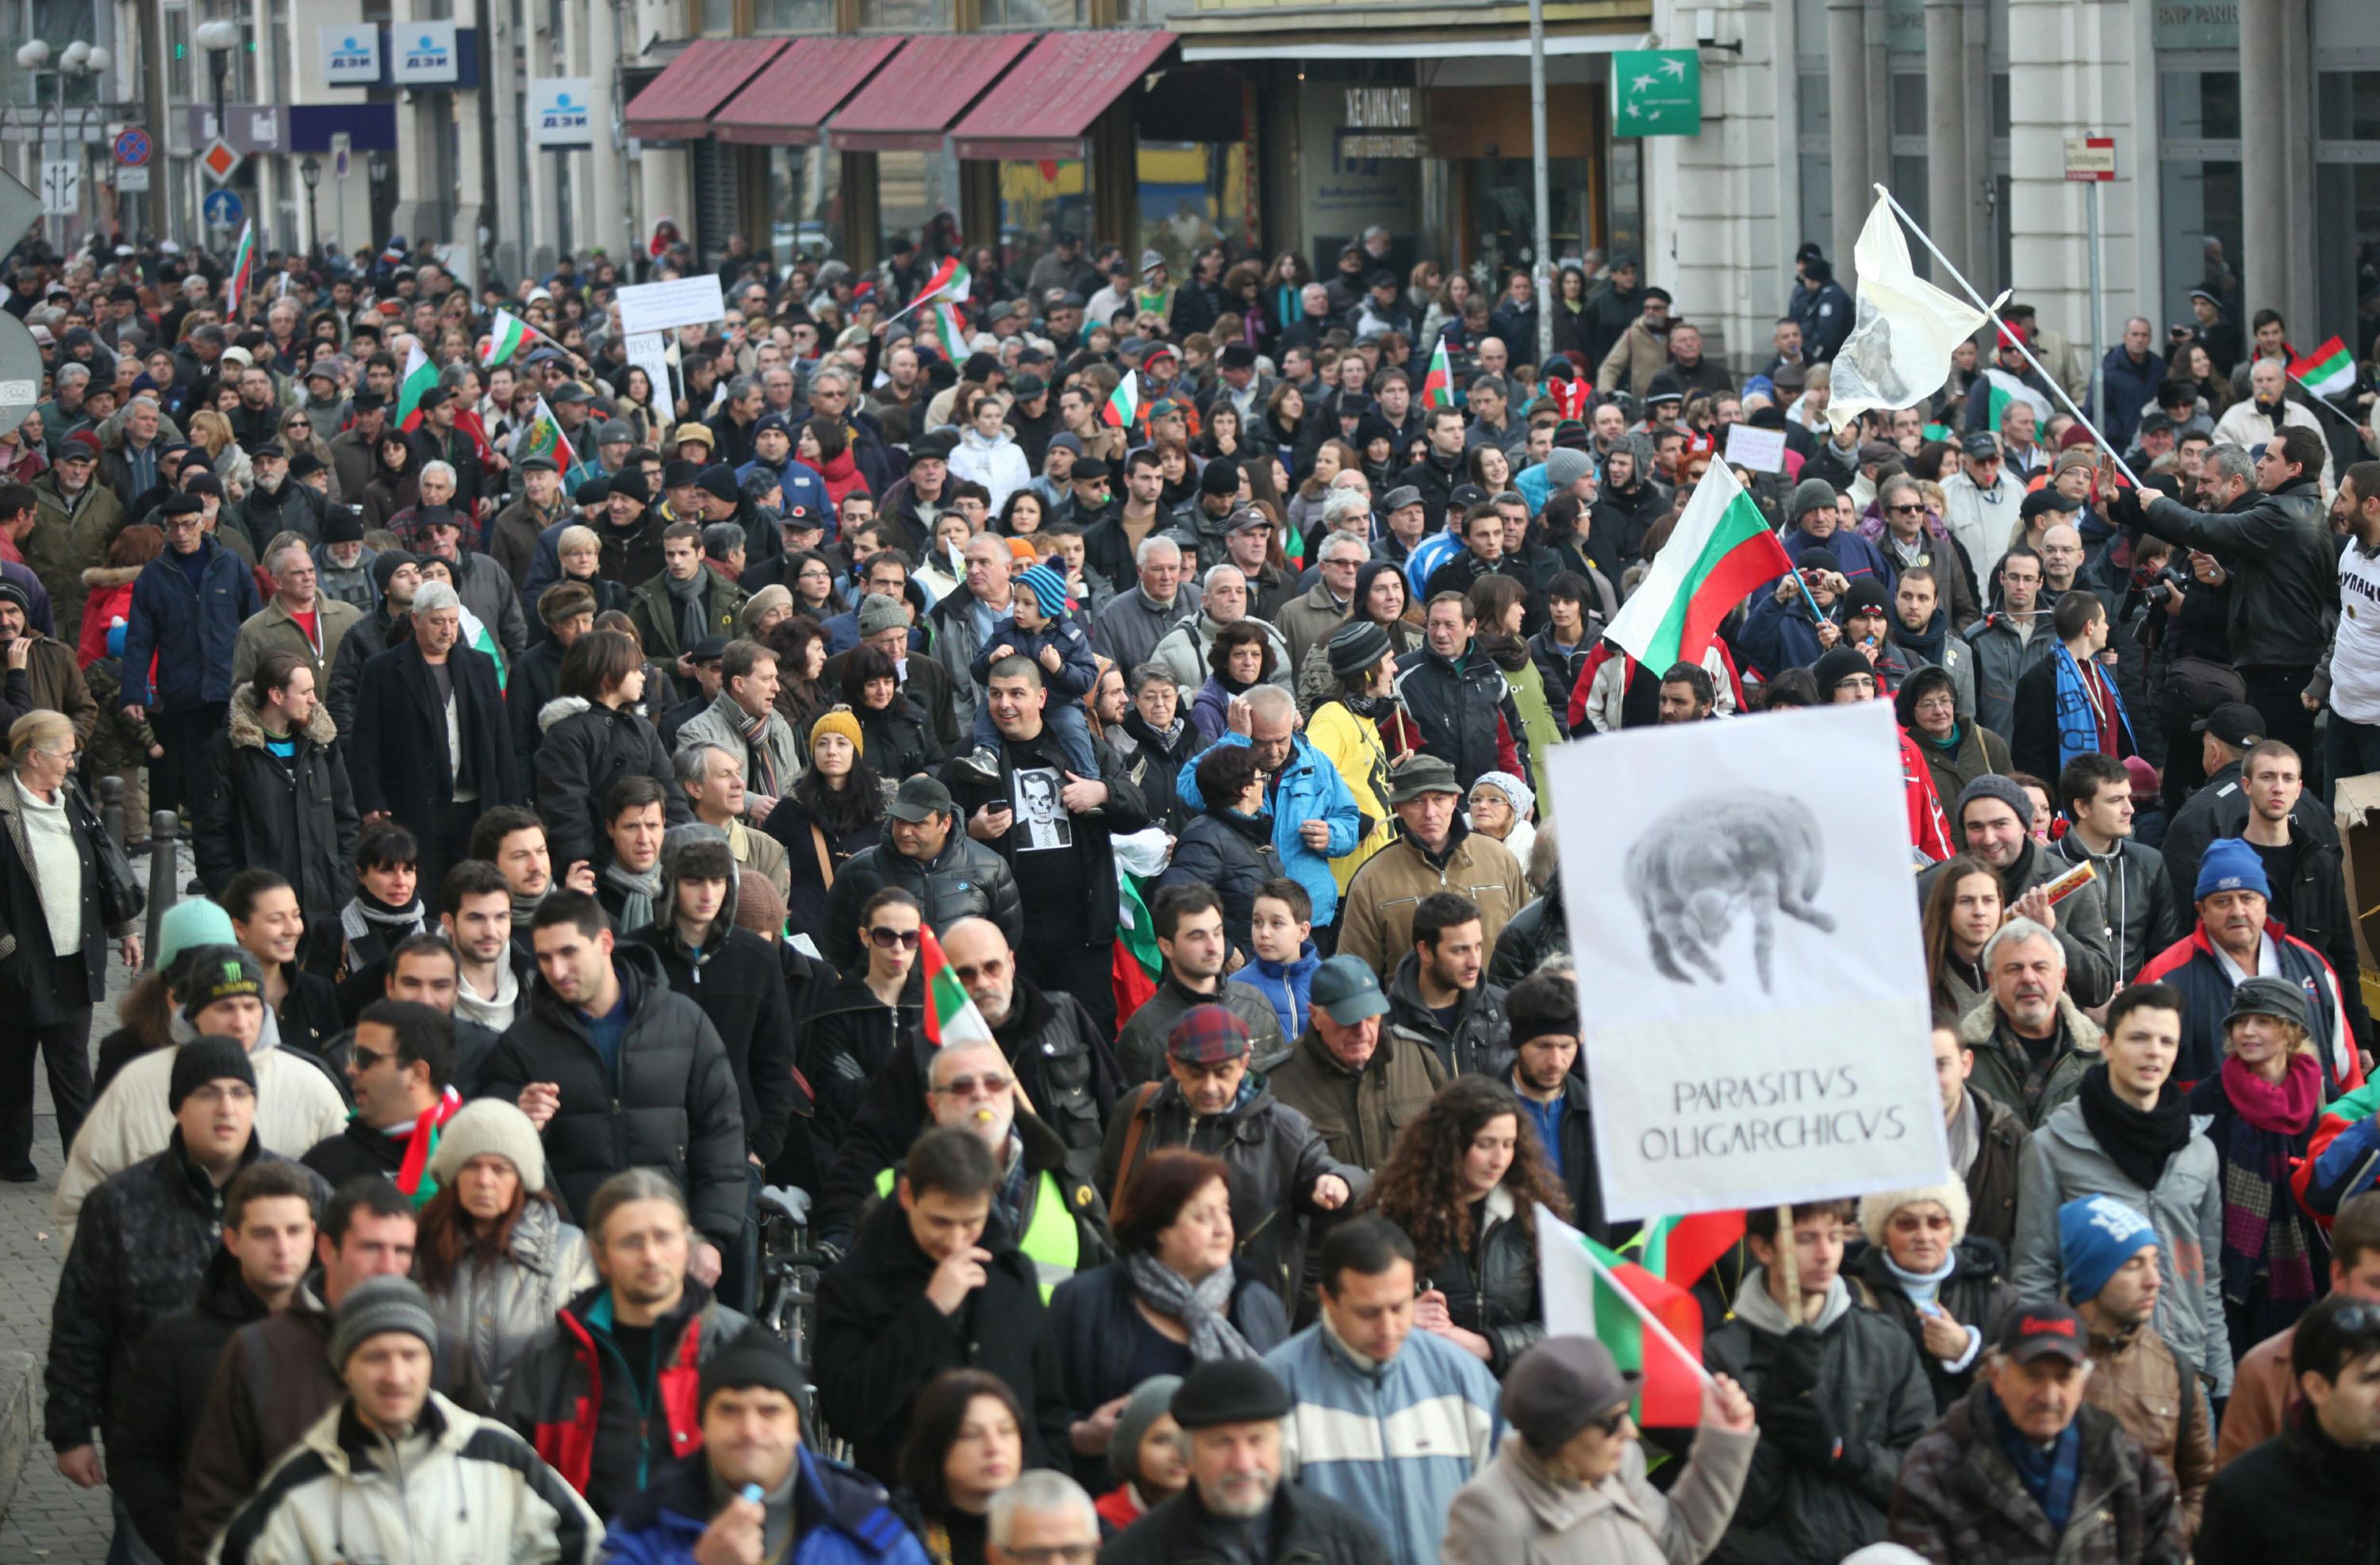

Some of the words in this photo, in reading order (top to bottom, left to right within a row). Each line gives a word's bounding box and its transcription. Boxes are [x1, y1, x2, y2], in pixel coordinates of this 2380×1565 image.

[1345, 87, 1411, 127] ХЕЛИКОН
[1674, 1064, 1859, 1114] PARASITVS
[1640, 1104, 1907, 1163] OLIGARCHICVS
